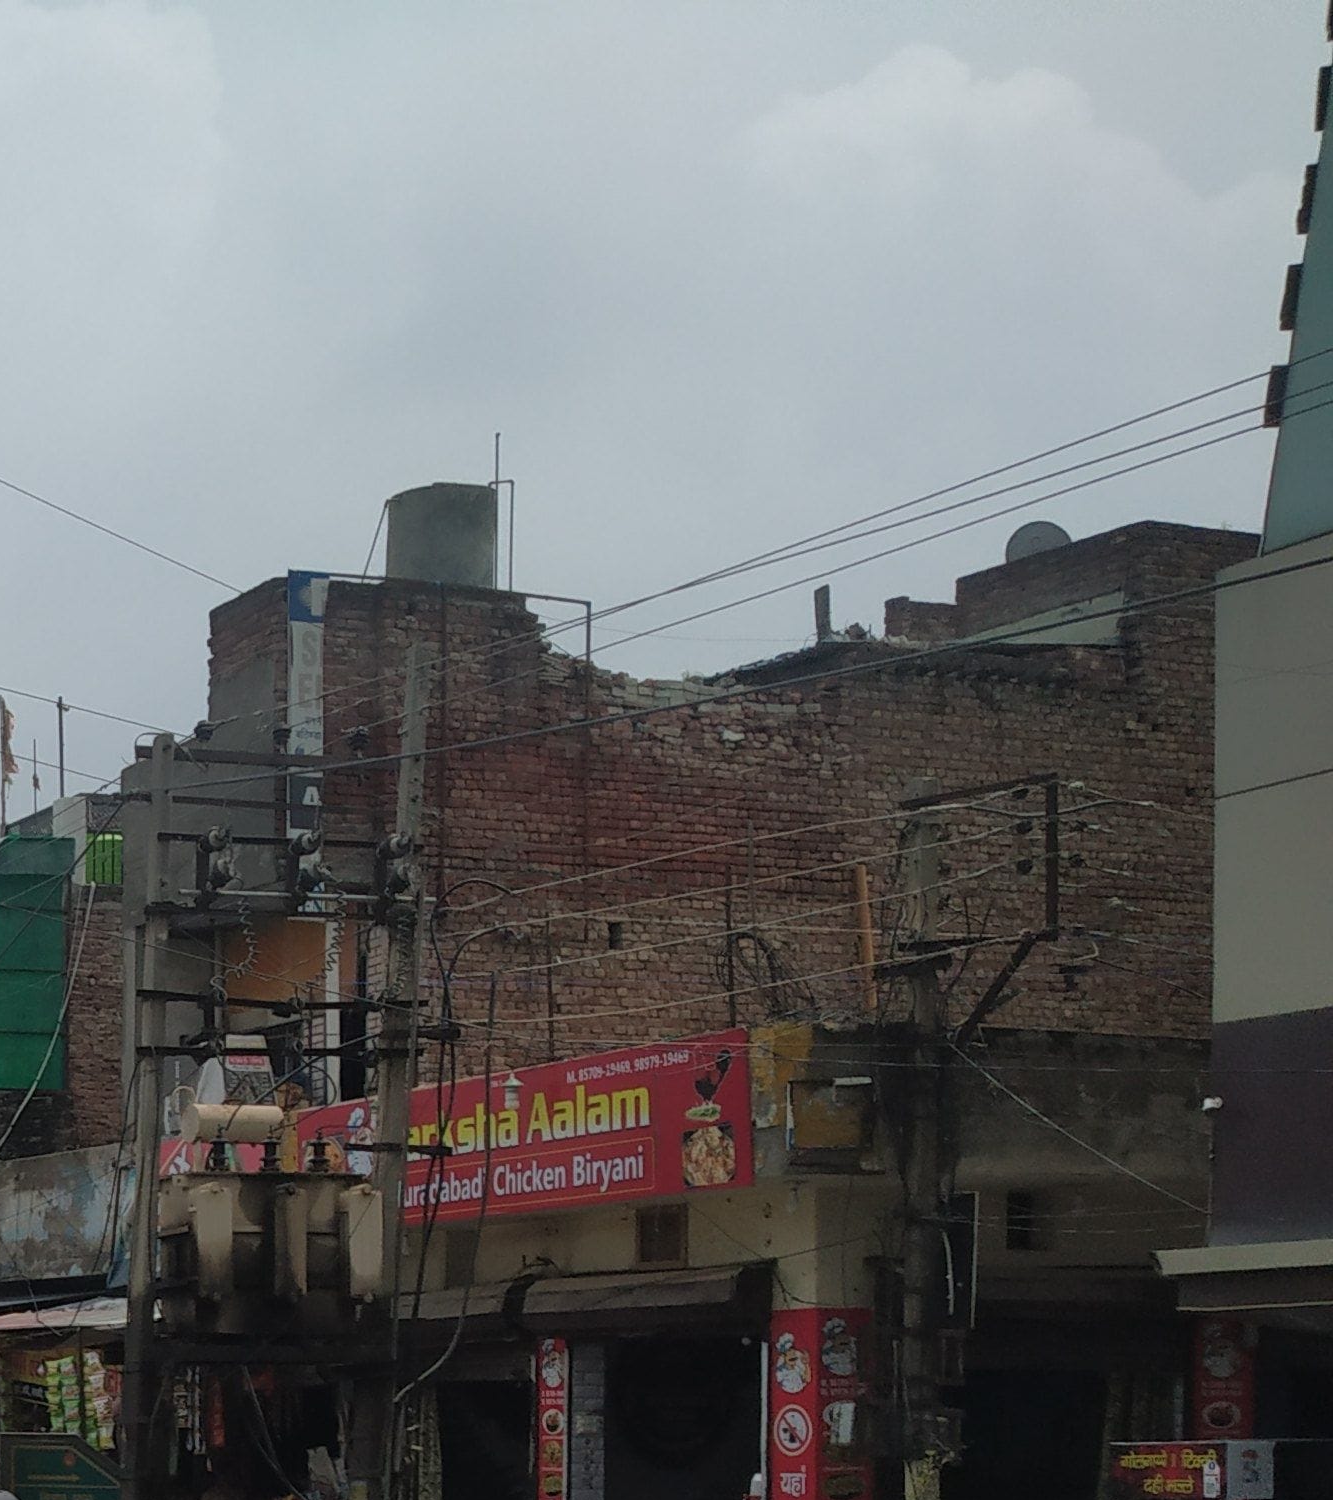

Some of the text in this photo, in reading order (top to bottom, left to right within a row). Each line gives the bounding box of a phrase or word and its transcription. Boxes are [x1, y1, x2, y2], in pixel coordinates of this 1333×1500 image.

[566, 1071, 577, 1084] M.
[526, 1085, 652, 1144] Aalam
[492, 1157, 568, 1197] Chicken
[571, 1145, 645, 1194] Biryani
[779, 1465, 807, 1496] यहां
